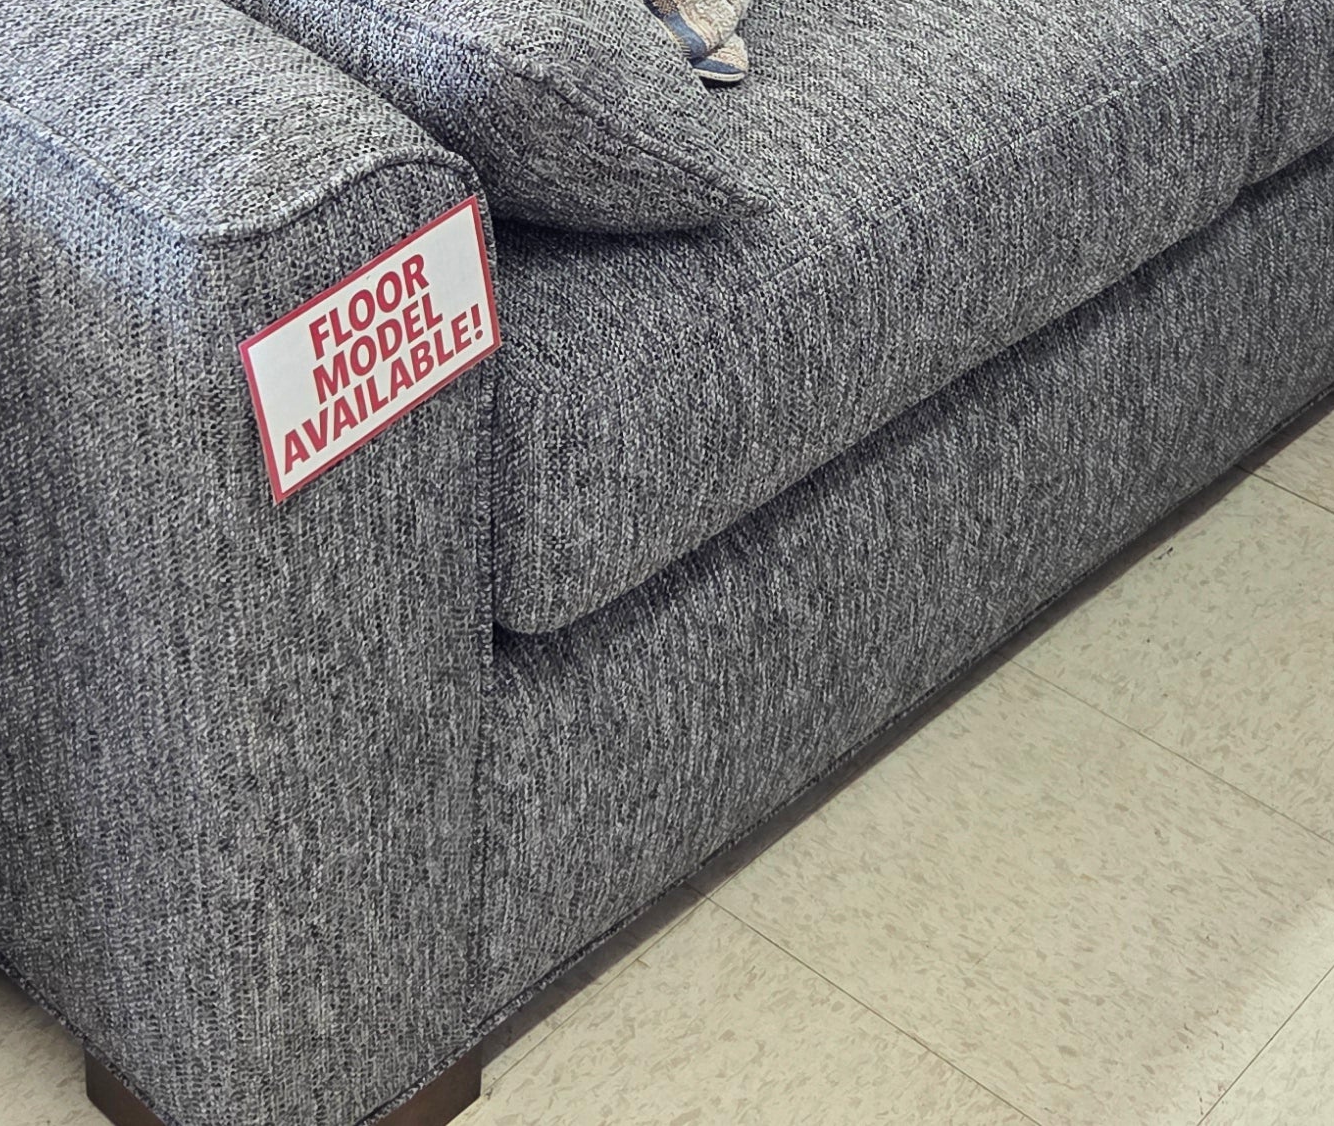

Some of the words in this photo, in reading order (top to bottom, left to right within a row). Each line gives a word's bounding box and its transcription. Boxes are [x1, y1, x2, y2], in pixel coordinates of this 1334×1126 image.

[308, 253, 430, 361] FLOOR
[312, 291, 443, 405] MODEL
[283, 303, 485, 475] AVAILABLE!
